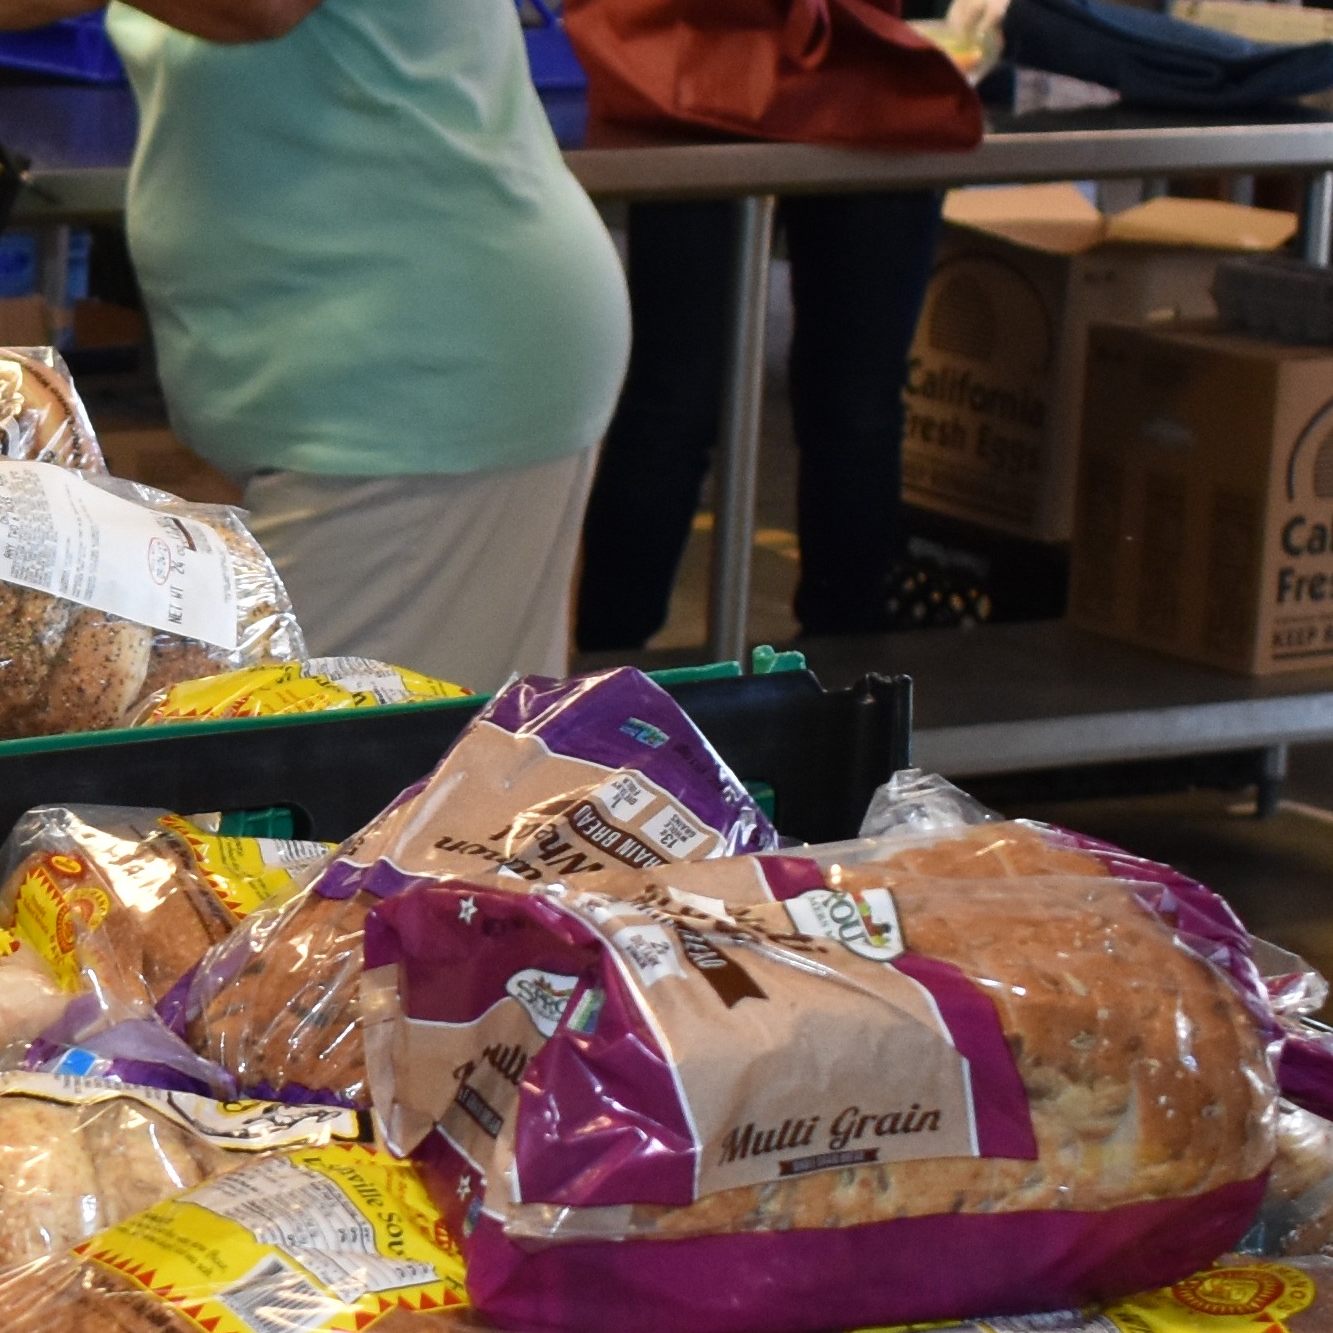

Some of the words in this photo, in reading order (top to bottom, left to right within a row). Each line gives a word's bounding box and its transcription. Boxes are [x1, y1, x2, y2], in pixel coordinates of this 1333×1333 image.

[1281, 515, 1333, 557] Ca
[1276, 567, 1333, 604] Fre
[168, 604, 183, 625] NET
[574, 804, 622, 848] BREAD
[614, 836, 667, 869] RAIN
[718, 1115, 821, 1167] Multi
[828, 1102, 942, 1151] Grain
